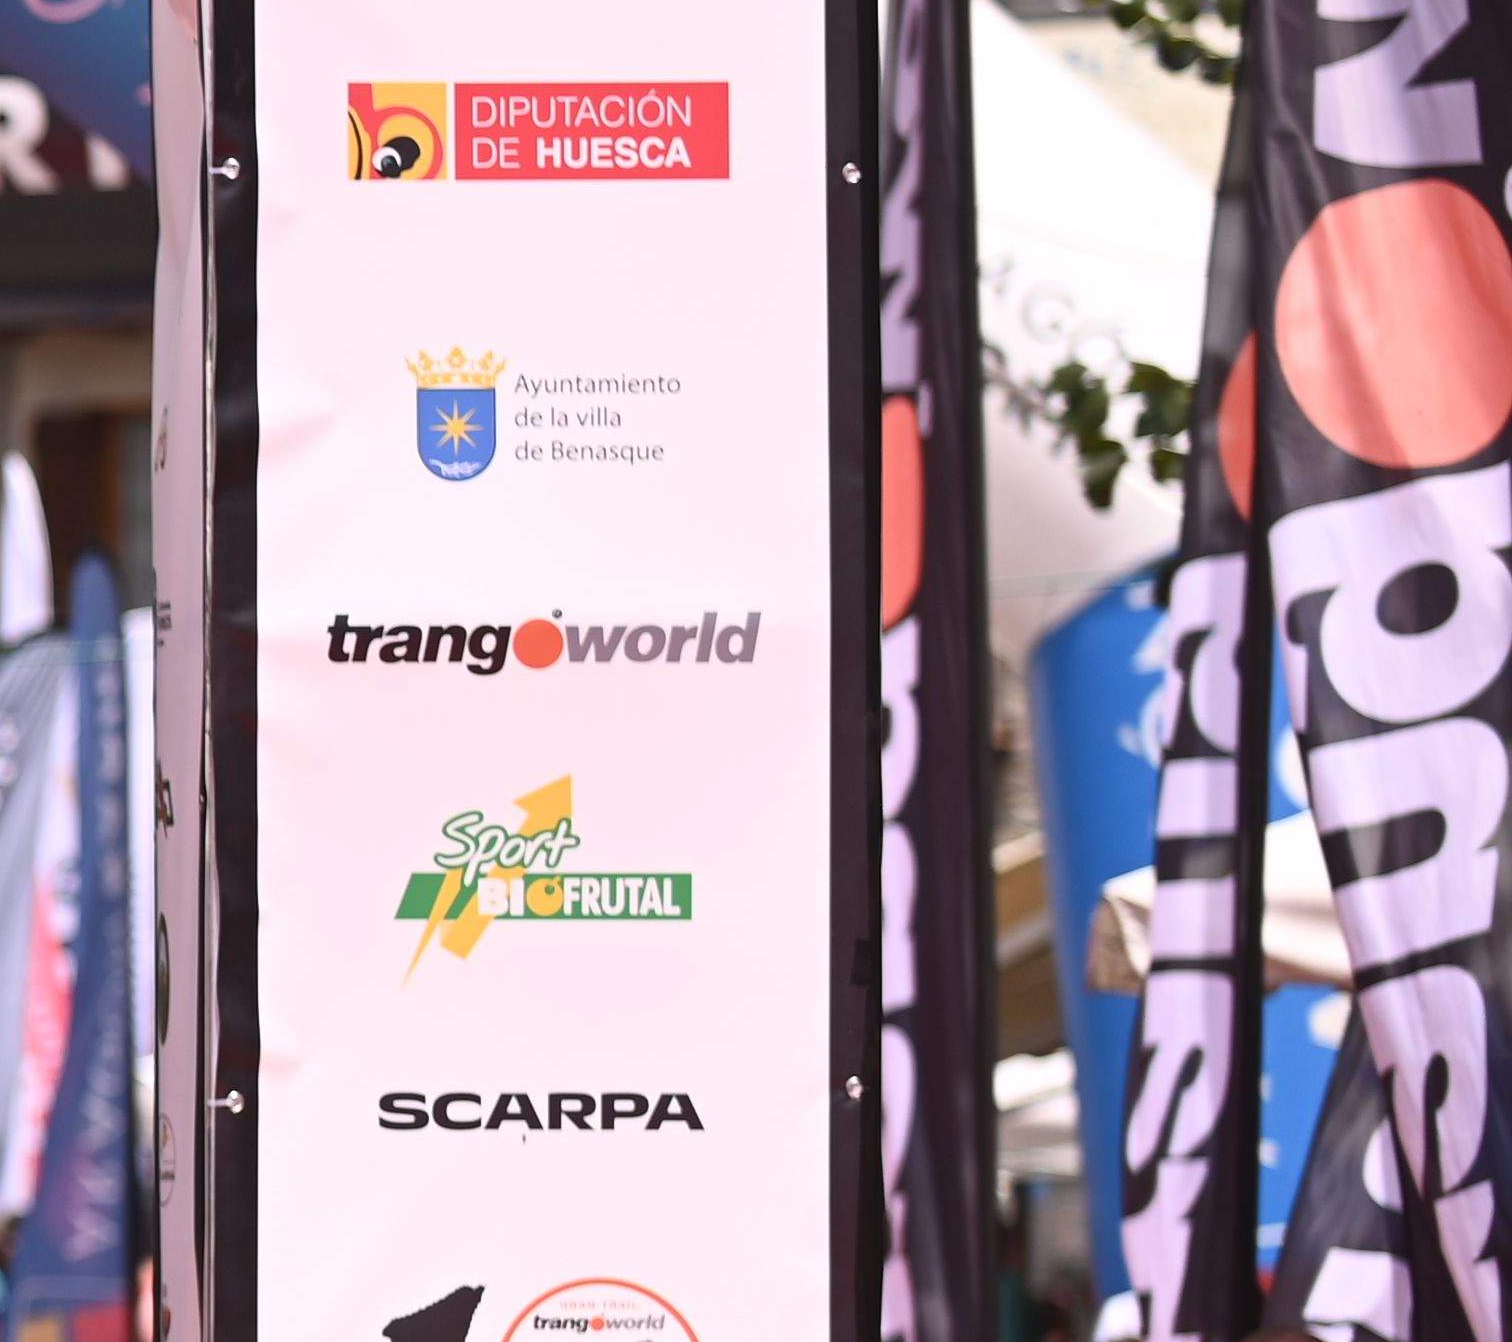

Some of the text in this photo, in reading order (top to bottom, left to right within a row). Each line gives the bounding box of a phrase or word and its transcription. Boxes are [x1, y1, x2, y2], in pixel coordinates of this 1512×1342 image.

[471, 88, 693, 128] DIPUTACIÓN
[471, 135, 693, 170] DE HUESCA
[514, 373, 682, 398] Ayuntamiento
[514, 406, 623, 428] de la villa
[514, 440, 665, 465] de Benasque
[325, 611, 762, 676] trangoworld
[433, 810, 581, 887] Sport
[477, 875, 682, 918] BIOFRUTAL
[378, 1092, 706, 1131] SCARPA
[533, 1314, 666, 1333] trangoworld
